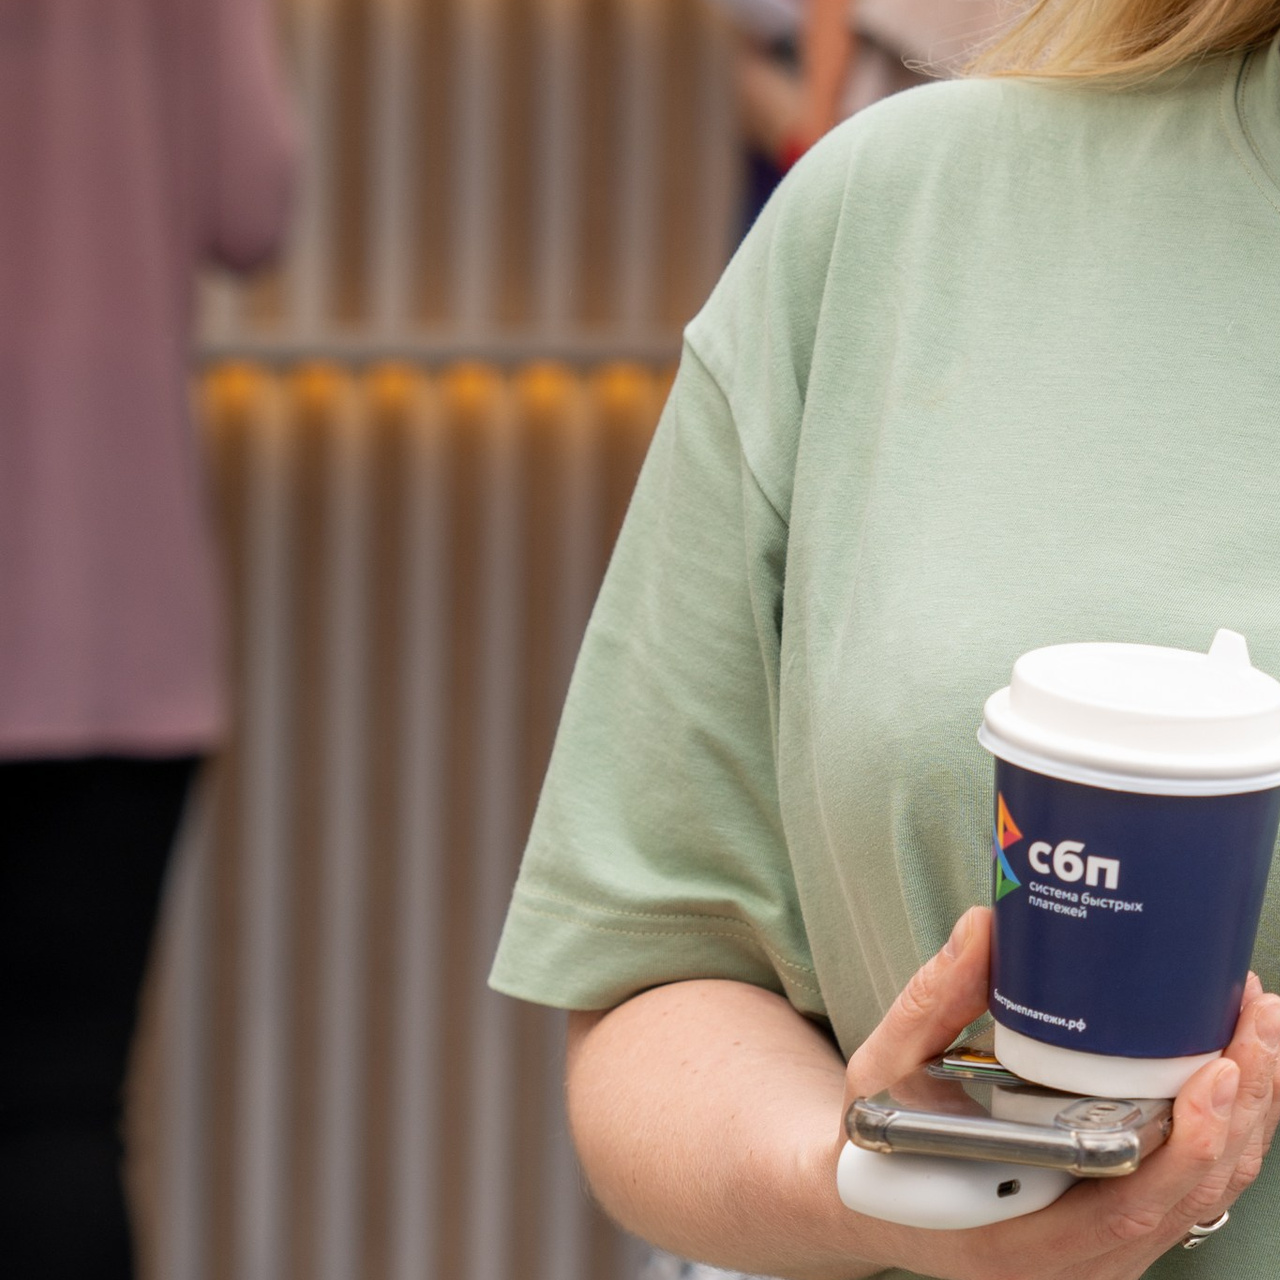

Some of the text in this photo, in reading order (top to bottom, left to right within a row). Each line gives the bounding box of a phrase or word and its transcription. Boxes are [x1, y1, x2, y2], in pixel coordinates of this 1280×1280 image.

[1028, 840, 1120, 890] сбп
[1028, 895, 1088, 919] платежей
[1029, 881, 1143, 913] система быстрых
[994, 988, 1087, 1032] быстрыеплатежи.рф
